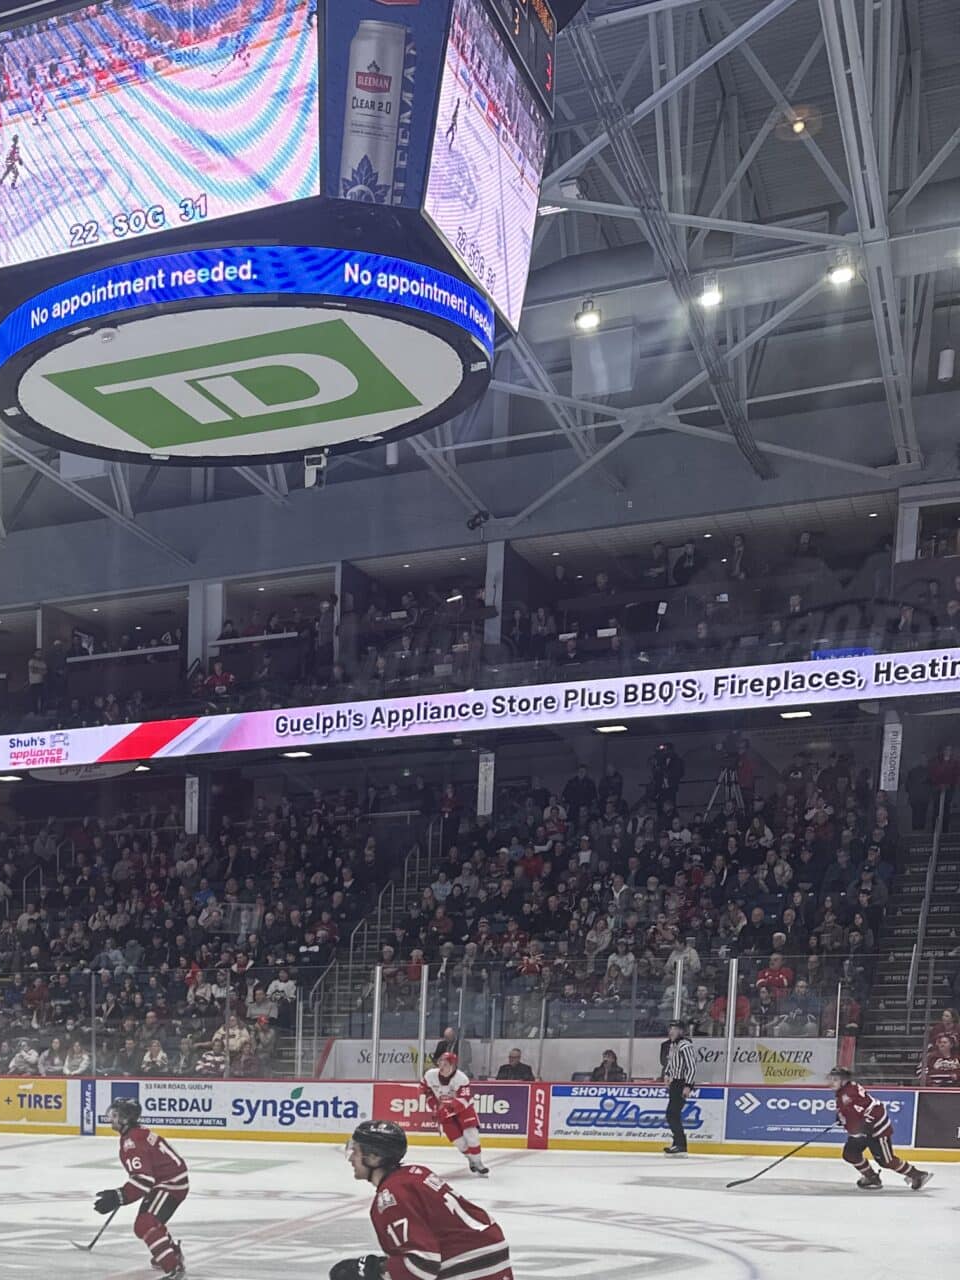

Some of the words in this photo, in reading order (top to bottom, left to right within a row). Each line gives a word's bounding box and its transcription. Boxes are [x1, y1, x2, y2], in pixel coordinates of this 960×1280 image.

[352, 96, 376, 110] CLEAR
[377, 101, 392, 114] 2.0
[70, 221, 98, 247] 22
[113, 205, 165, 237] SOG
[179, 193, 208, 222] 31
[30, 307, 49, 329] No
[51, 269, 165, 319] appointment
[171, 259, 258, 287] needed.
[343, 262, 373, 286] No
[376, 272, 469, 316] appointment
[94, 352, 359, 425] TD
[275, 708, 364, 736] Guelph's
[370, 700, 485, 729] Appliance
[491, 694, 557, 716] Store
[563, 686, 616, 710] Plus
[623, 678, 706, 703] BBQ'S,
[713, 669, 865, 698] Fireplaces,
[9, 736, 46, 749] Shuh's
[9, 747, 63, 760] appliance
[25, 756, 63, 766] CENTRE
[695, 1046, 813, 1064] SericeMASTER
[765, 1066, 807, 1078] Restore
[16, 1093, 63, 1109] TIRES
[571, 1086, 701, 1098] SHOPWILSONS.M
[144, 1097, 213, 1112] GERDAU
[231, 1094, 359, 1126] syngenta
[533, 1088, 546, 1138] CCM
[493, 1122, 520, 1130] EVENTS
[582, 1129, 623, 1137] Wilson's
[625, 1130, 659, 1138] Better
[688, 1132, 713, 1140] Cars
[158, 1141, 183, 1167] 1
[126, 1156, 143, 1172] 16
[386, 1217, 409, 1247] 17
